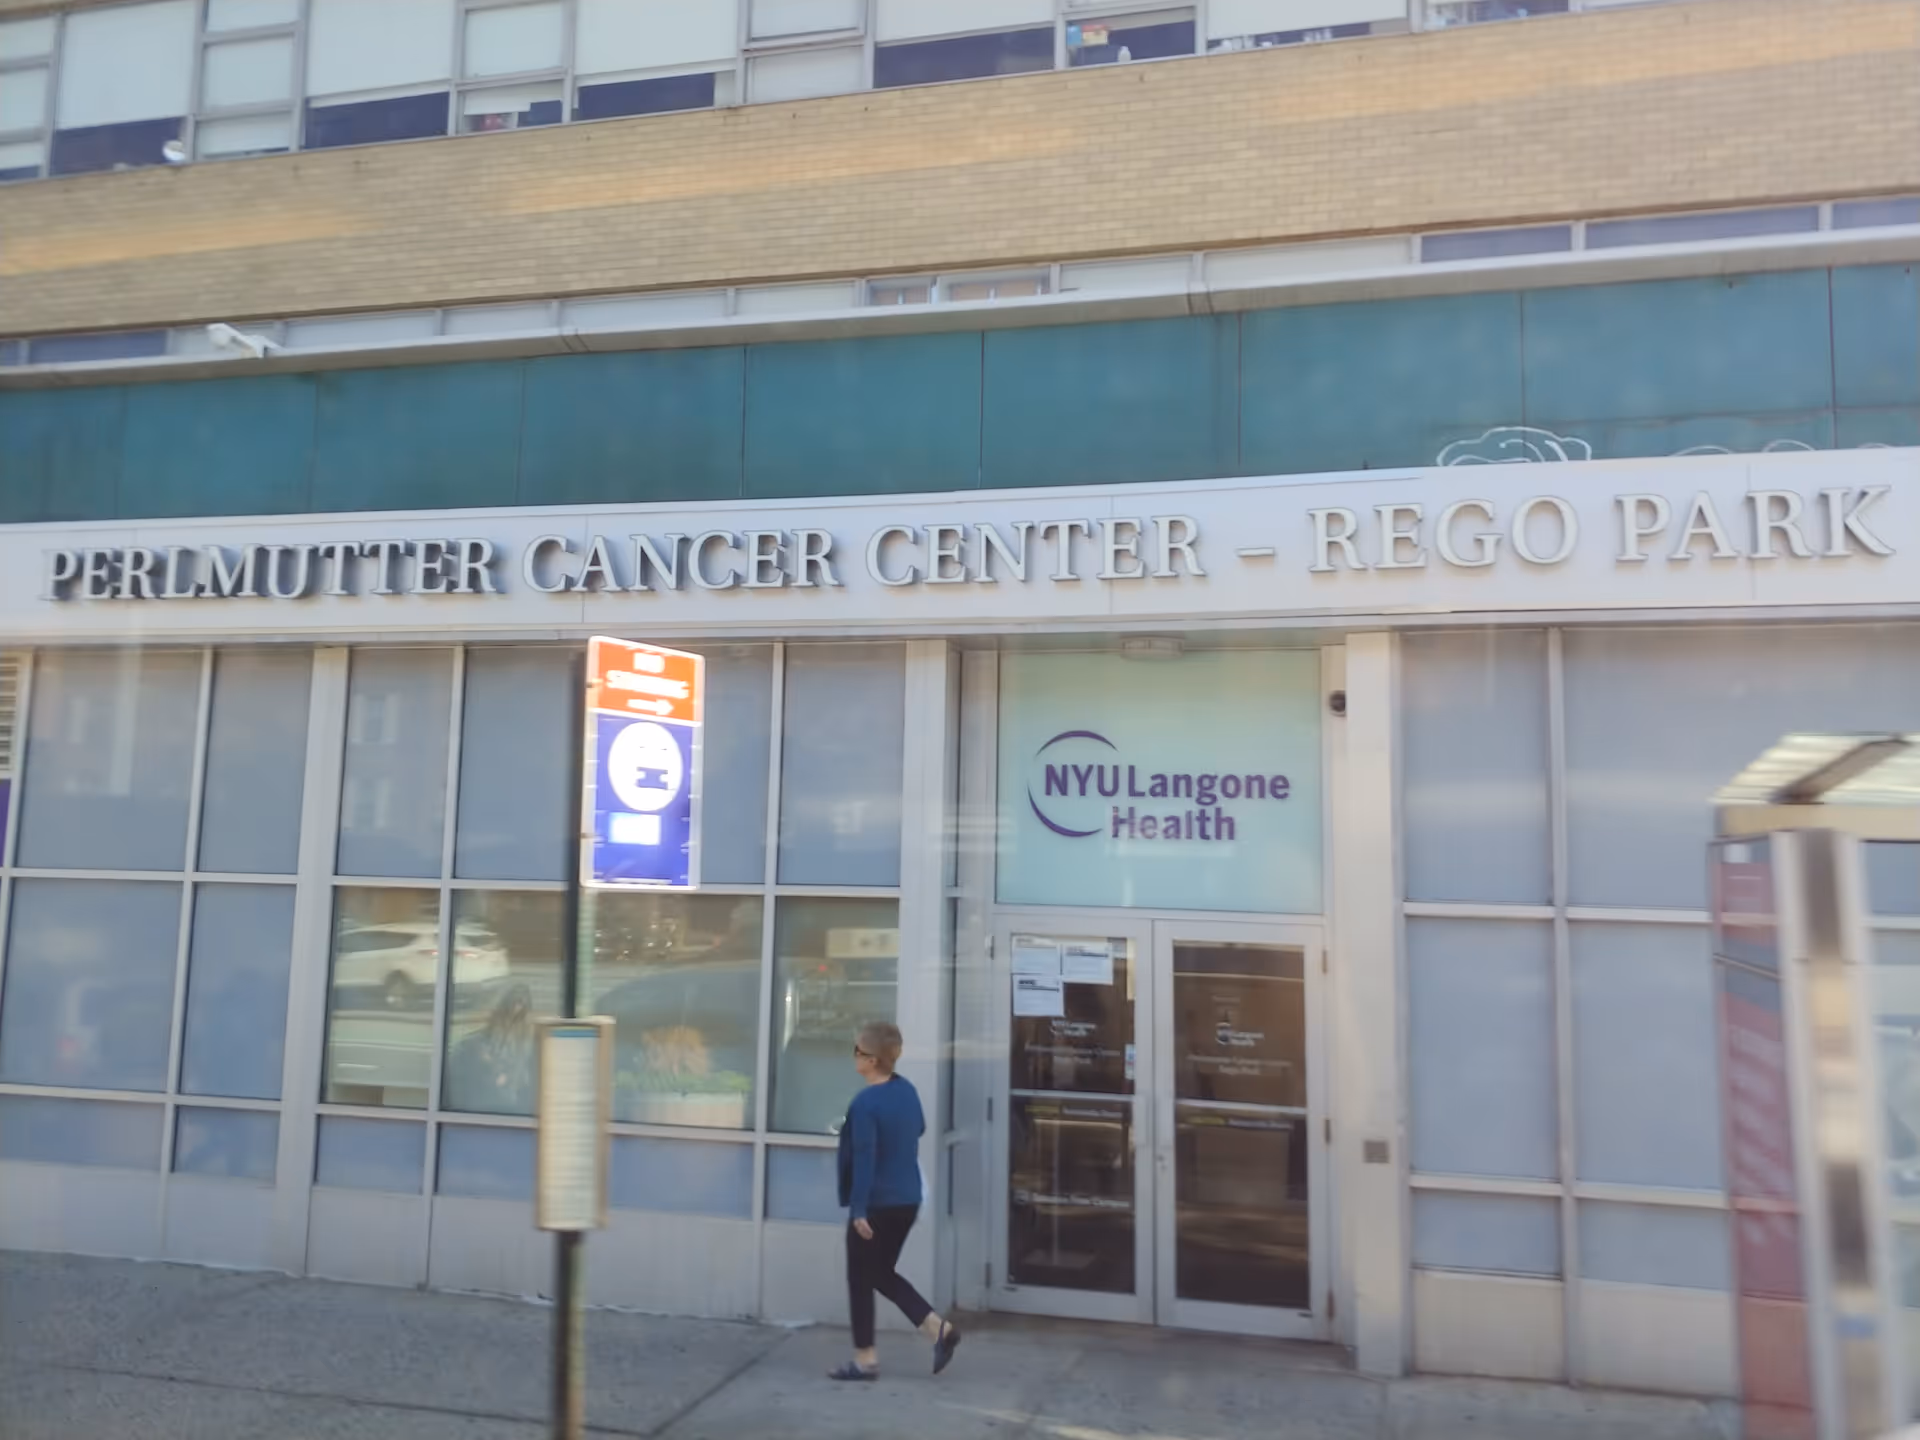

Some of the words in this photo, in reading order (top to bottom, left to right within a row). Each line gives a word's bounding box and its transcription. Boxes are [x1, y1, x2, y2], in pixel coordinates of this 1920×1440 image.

[44, 537, 500, 600] PERLMUTTER
[521, 528, 840, 593] CANCER
[865, 514, 1207, 587] CENTER
[1307, 495, 1579, 573] REGO
[1614, 484, 1896, 563] PARK
[1044, 763, 1120, 798] NYU
[1127, 764, 1291, 806] Langone
[1111, 805, 1236, 841] Health
